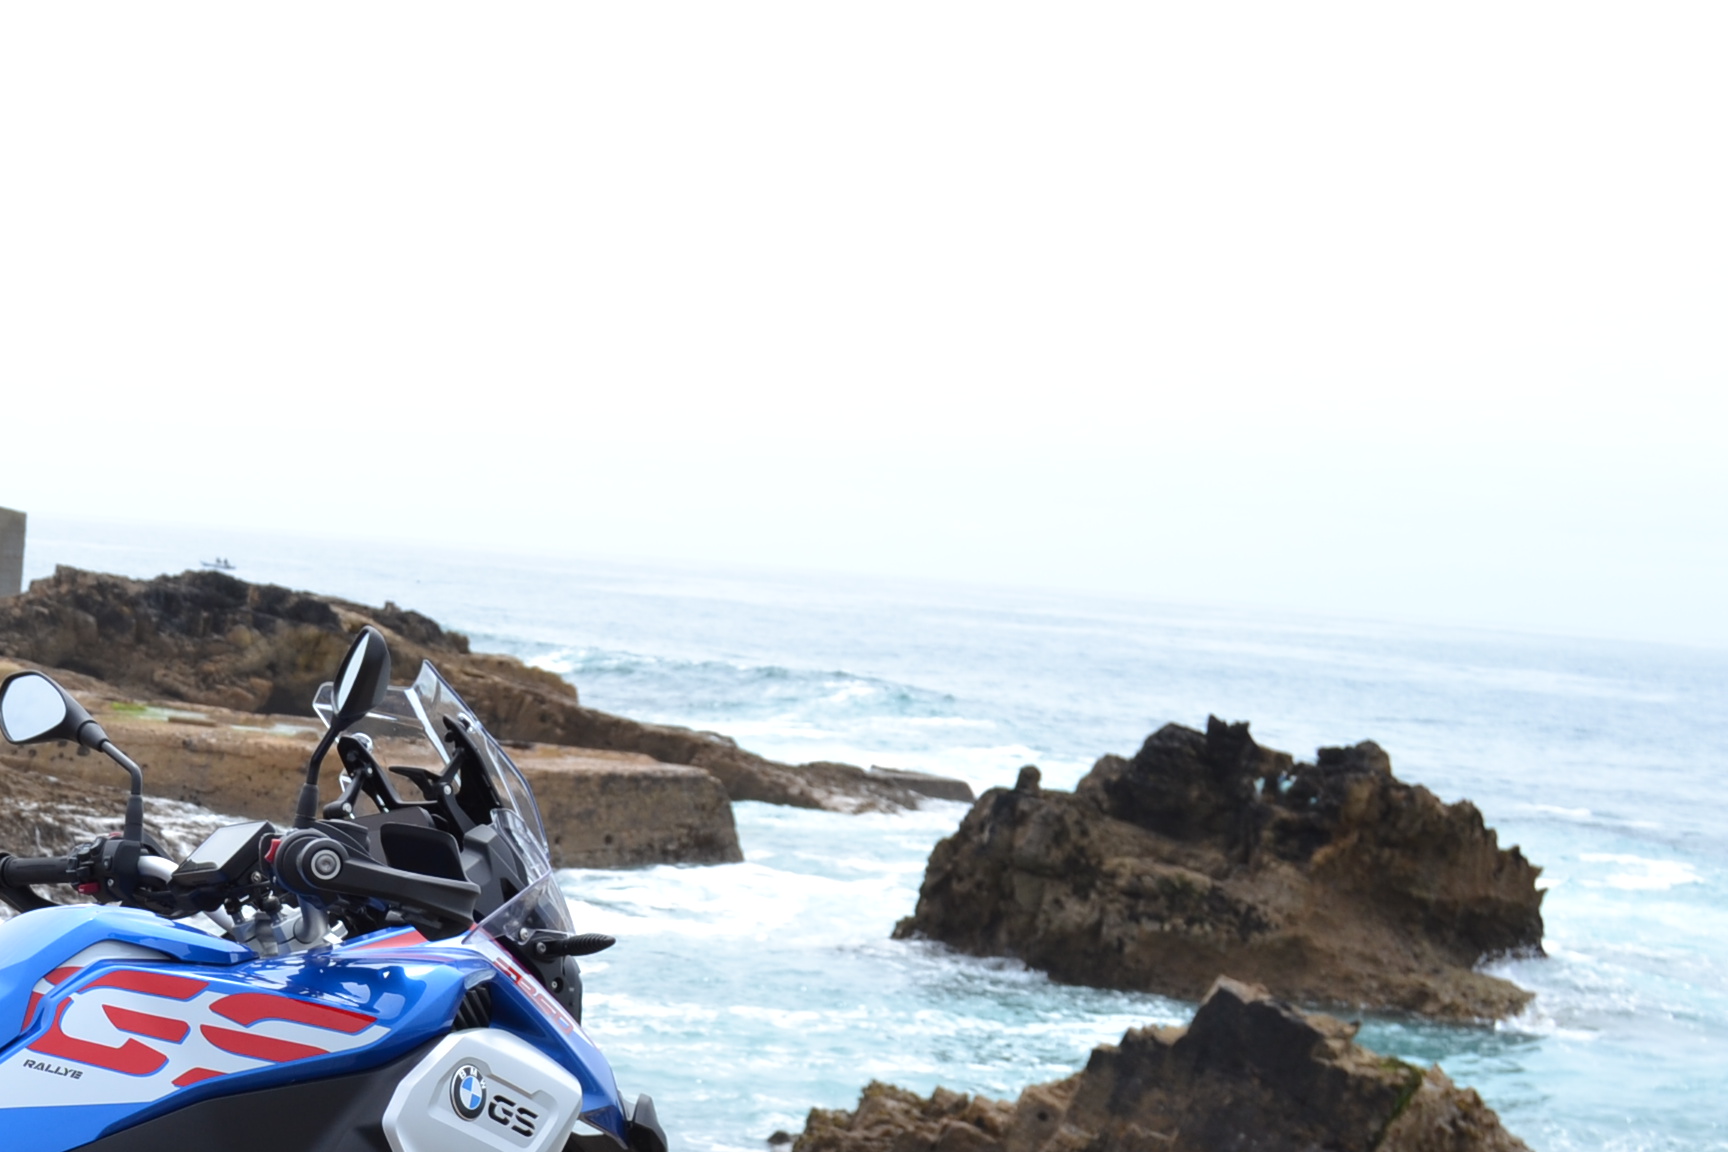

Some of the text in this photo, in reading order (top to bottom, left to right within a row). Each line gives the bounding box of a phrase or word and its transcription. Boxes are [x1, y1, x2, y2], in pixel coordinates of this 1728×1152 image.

[22, 966, 378, 1088] GS
[23, 1059, 83, 1080] RALLYE
[488, 1095, 539, 1137] GS
